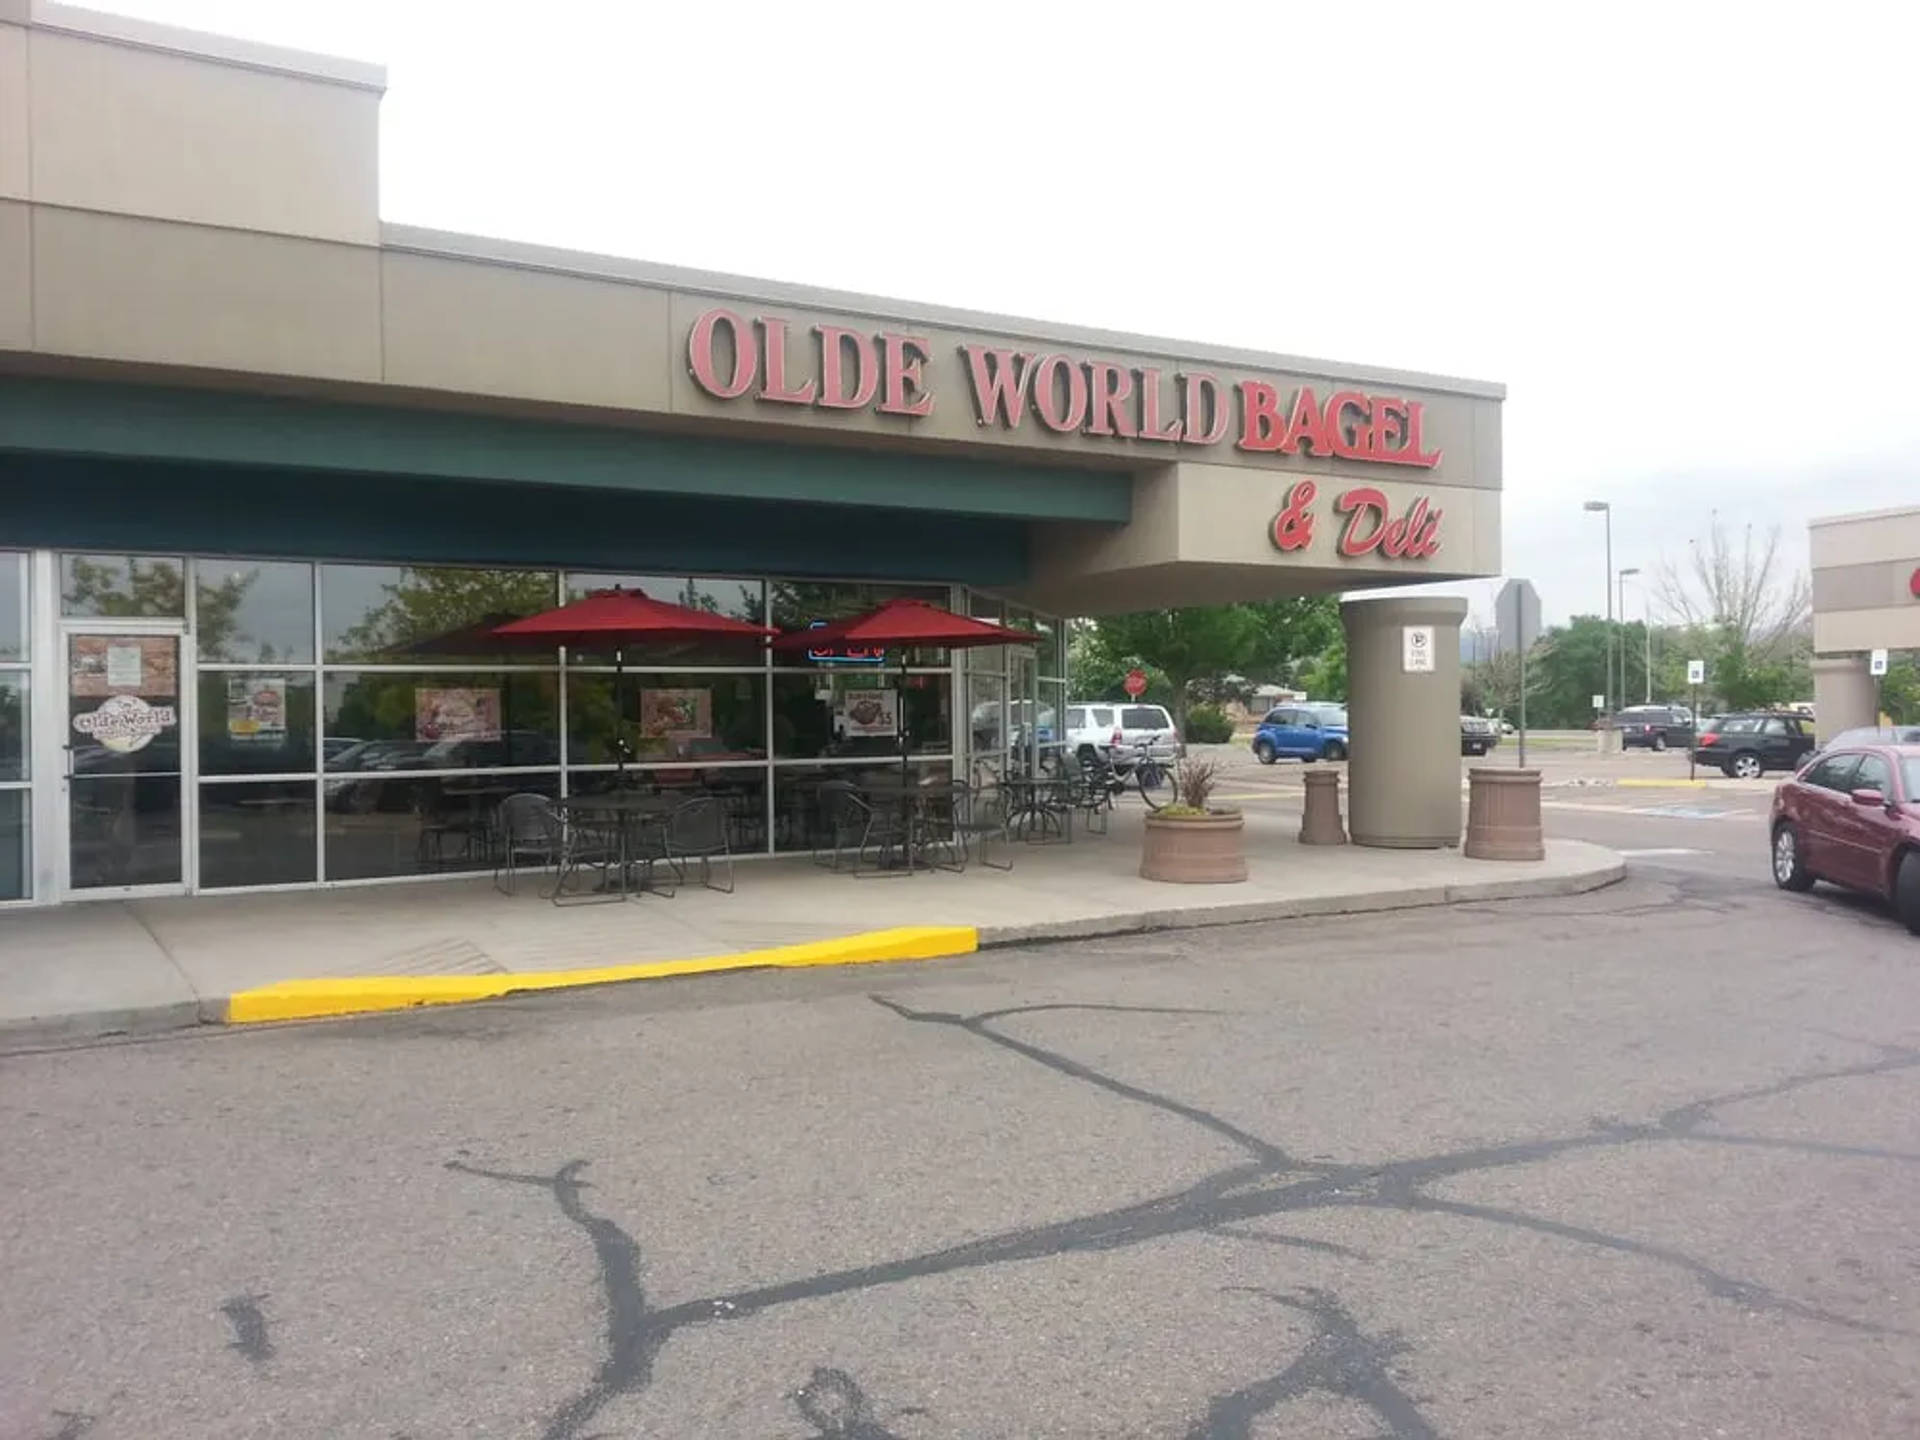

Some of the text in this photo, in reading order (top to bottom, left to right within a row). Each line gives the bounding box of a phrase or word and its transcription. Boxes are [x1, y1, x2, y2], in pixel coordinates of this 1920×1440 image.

[687, 308, 1443, 468] OLDE WORLD BAGEL
[1274, 481, 1444, 558] & Deli
